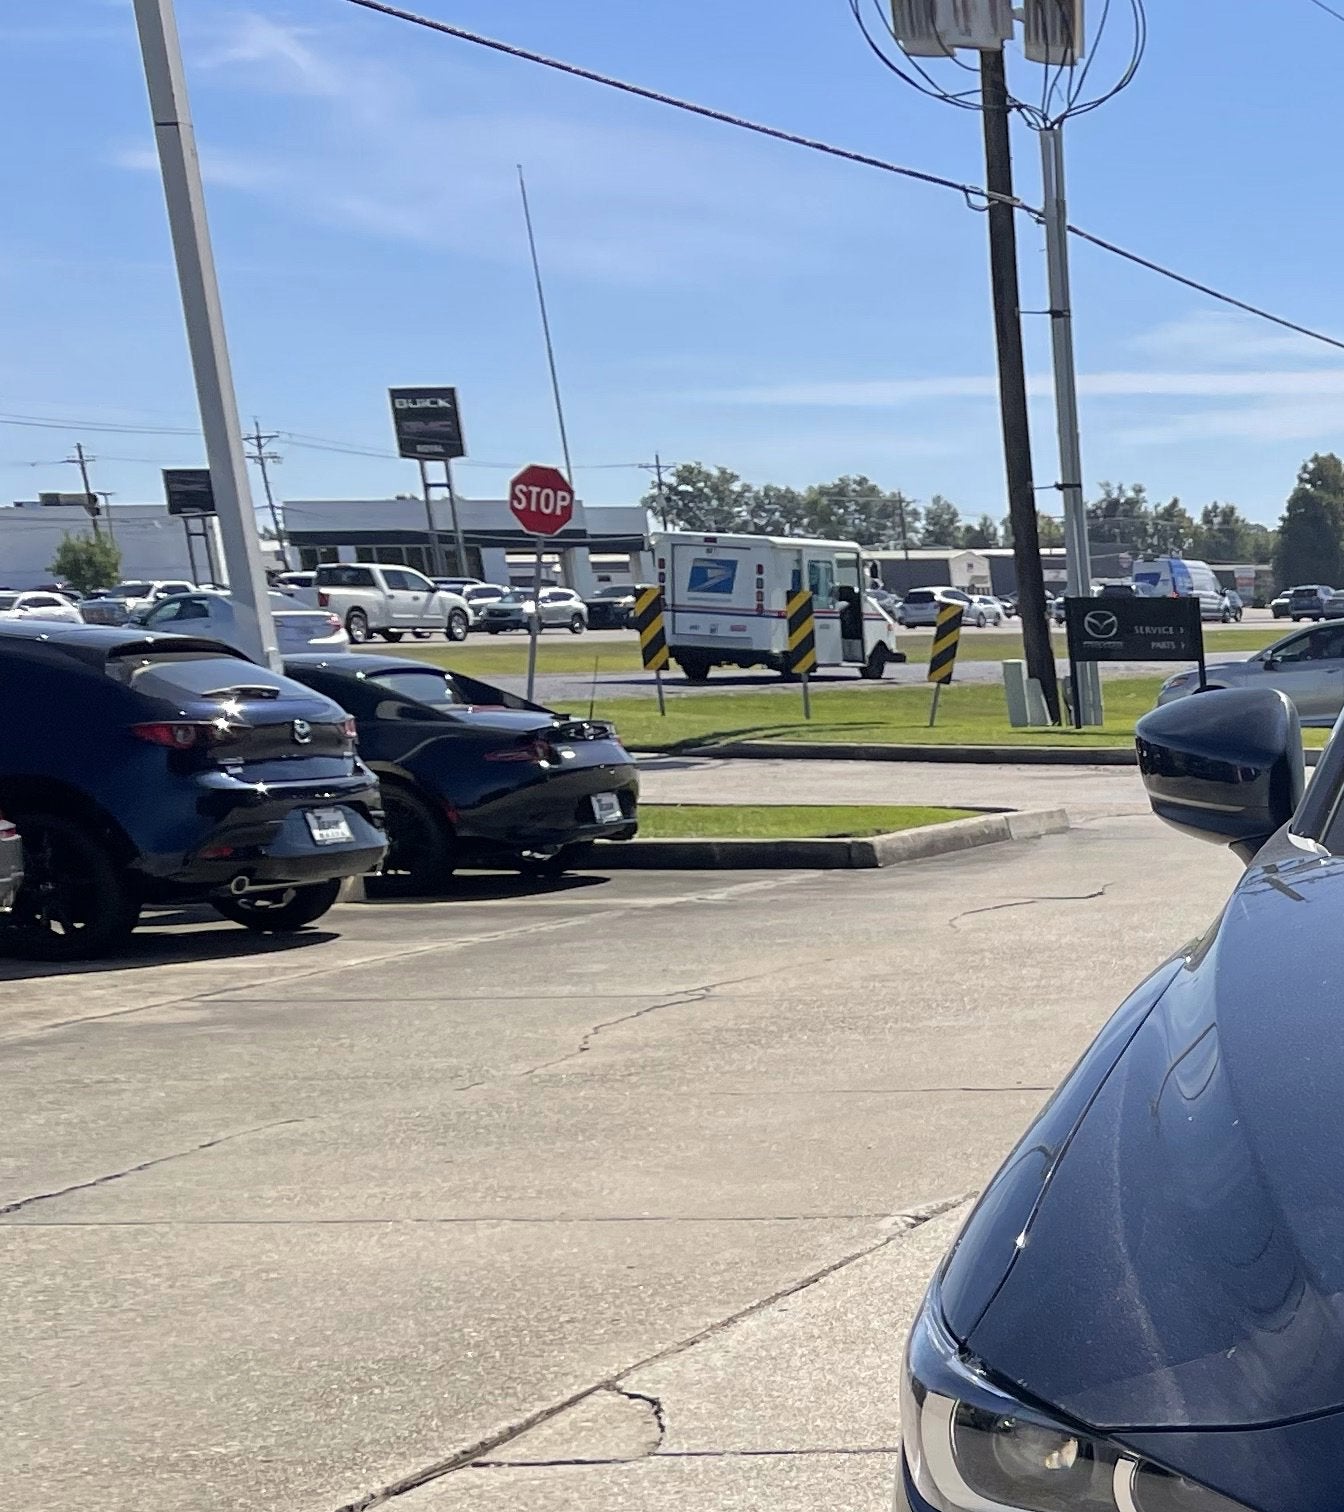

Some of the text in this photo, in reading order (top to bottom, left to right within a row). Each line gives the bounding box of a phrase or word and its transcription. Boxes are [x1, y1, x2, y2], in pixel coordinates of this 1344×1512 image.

[513, 484, 571, 515] STOP
[1134, 626, 1174, 635] SERVICE
[1151, 641, 1176, 649] PARTS
